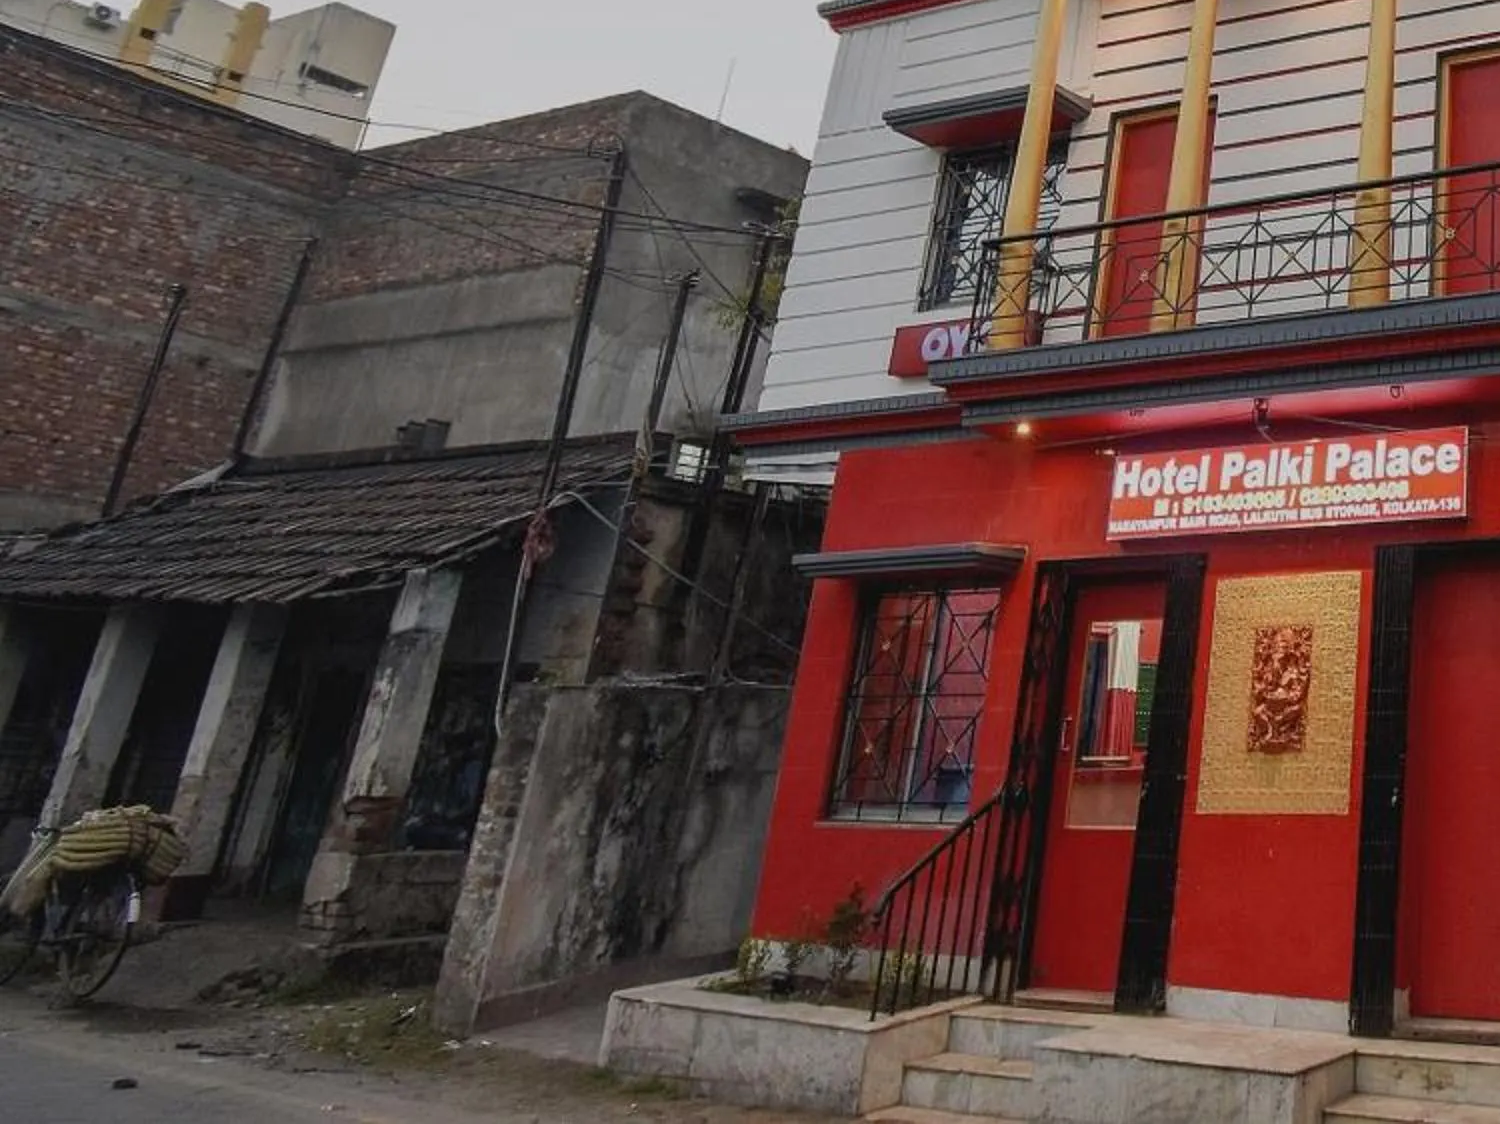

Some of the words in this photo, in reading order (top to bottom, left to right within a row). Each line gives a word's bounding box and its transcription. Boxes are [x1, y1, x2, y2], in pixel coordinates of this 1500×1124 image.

[1112, 454, 1211, 499] Hotel
[1219, 445, 1314, 490] Palki
[1326, 439, 1461, 483] Palace
